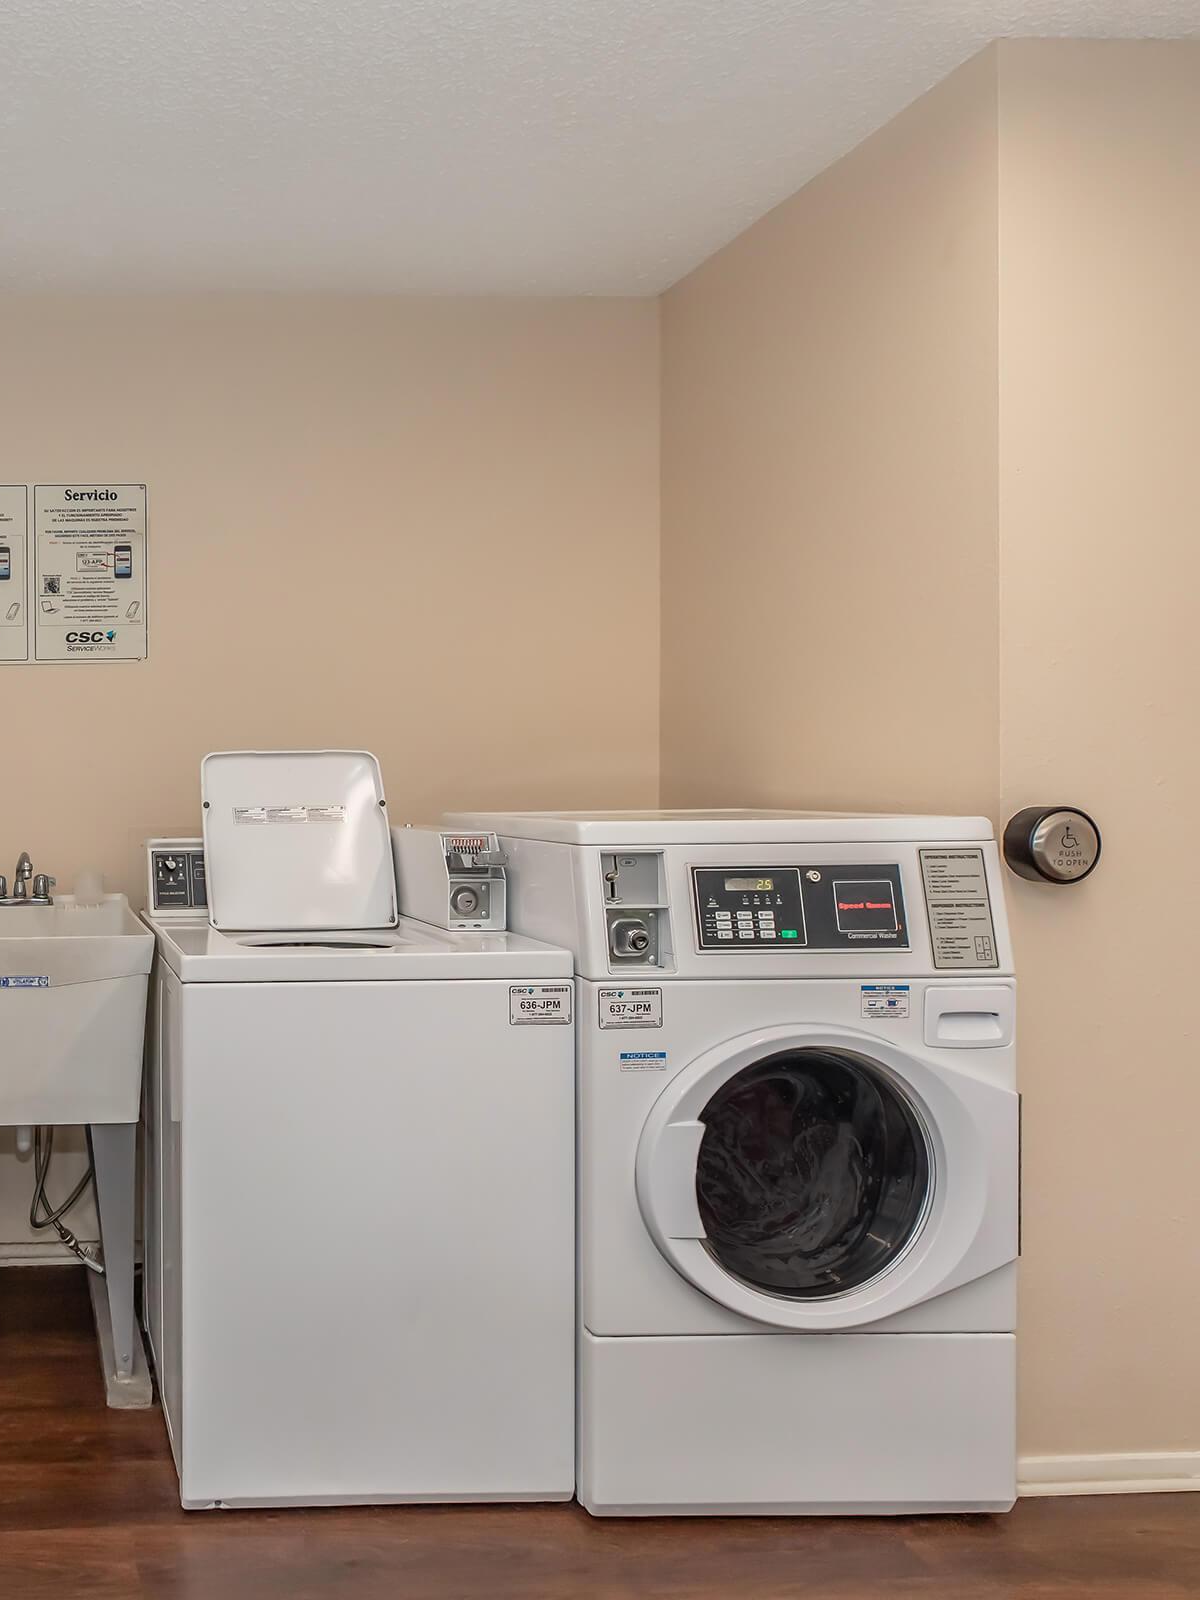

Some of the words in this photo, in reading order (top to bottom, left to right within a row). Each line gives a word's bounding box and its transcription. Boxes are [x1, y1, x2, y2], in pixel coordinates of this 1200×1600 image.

[65, 489, 118, 501] Servicio
[66, 632, 104, 643] CSC
[521, 1001, 561, 1010] 636-JPM
[610, 1004, 652, 1013] 637-JPM
